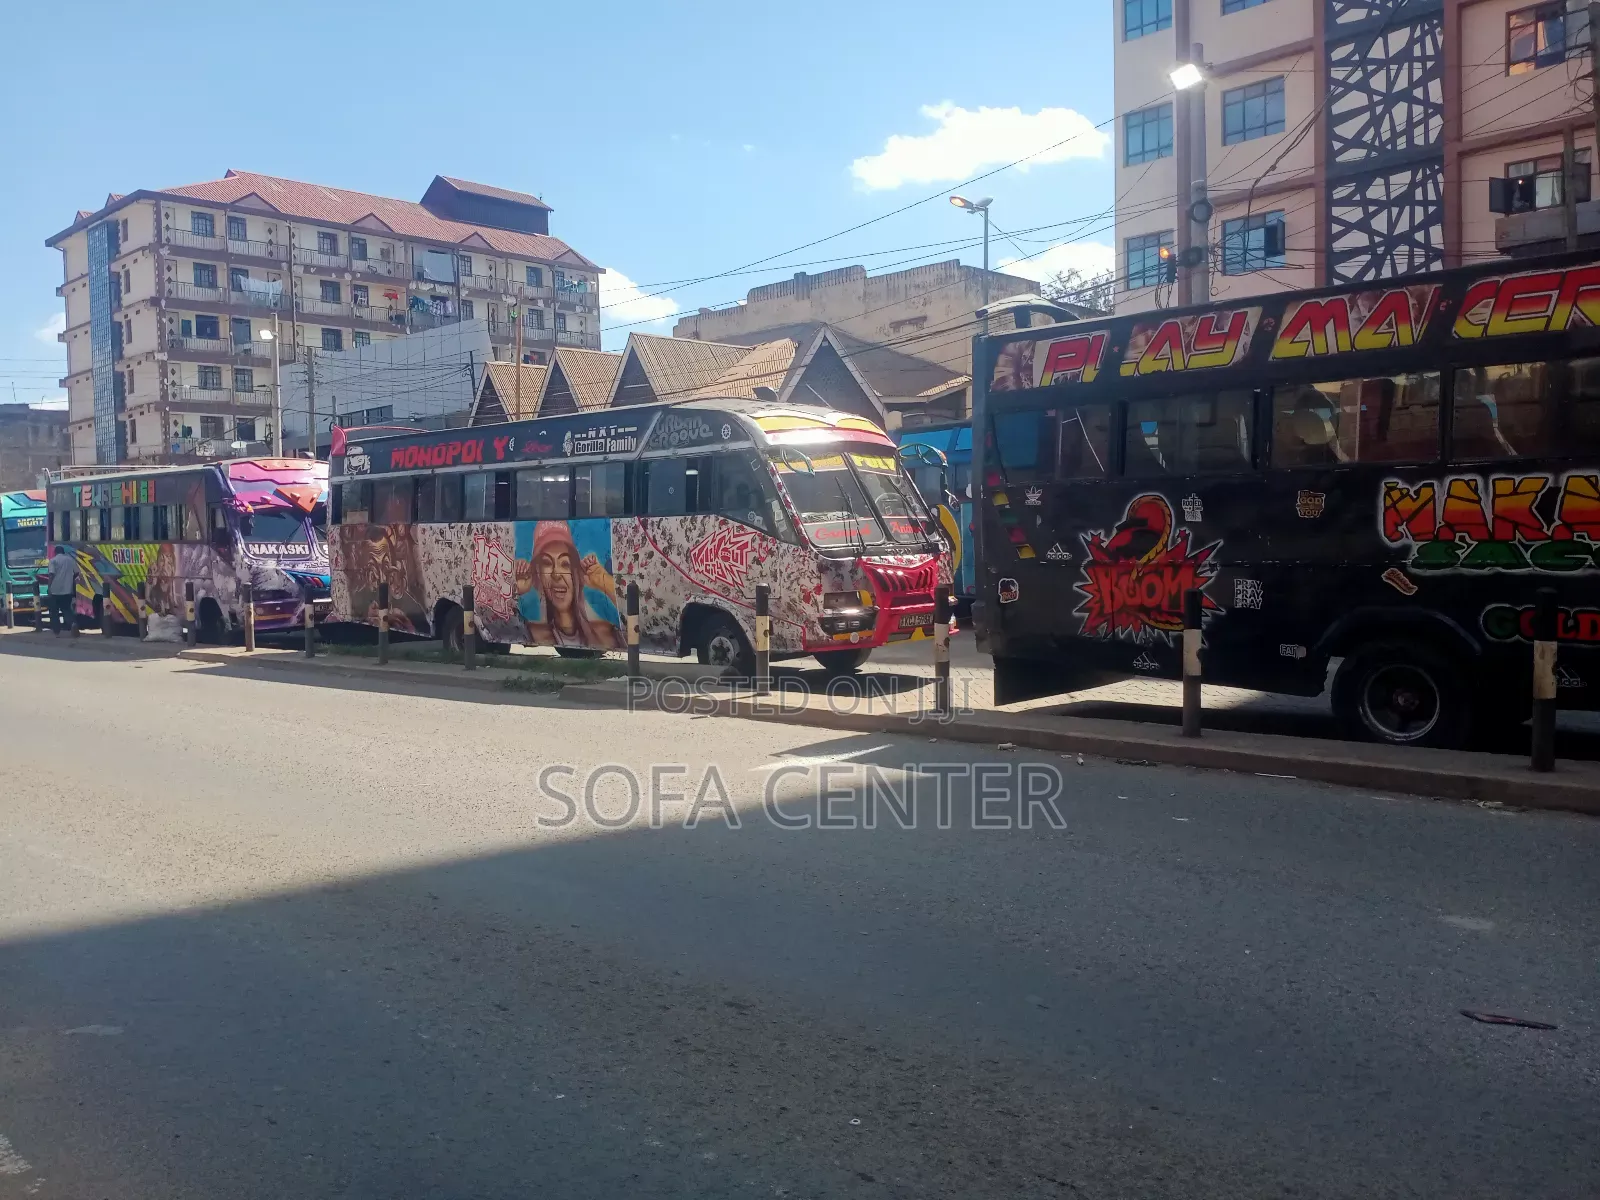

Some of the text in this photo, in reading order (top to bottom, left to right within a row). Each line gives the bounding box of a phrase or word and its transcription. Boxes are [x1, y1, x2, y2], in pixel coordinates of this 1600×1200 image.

[1038, 310, 1249, 388] PLAY
[575, 436, 637, 453] Gorilla Family
[1235, 579, 1263, 590] PRAY
[1235, 588, 1263, 600] PRAY
[1235, 598, 1262, 609] PRAY
